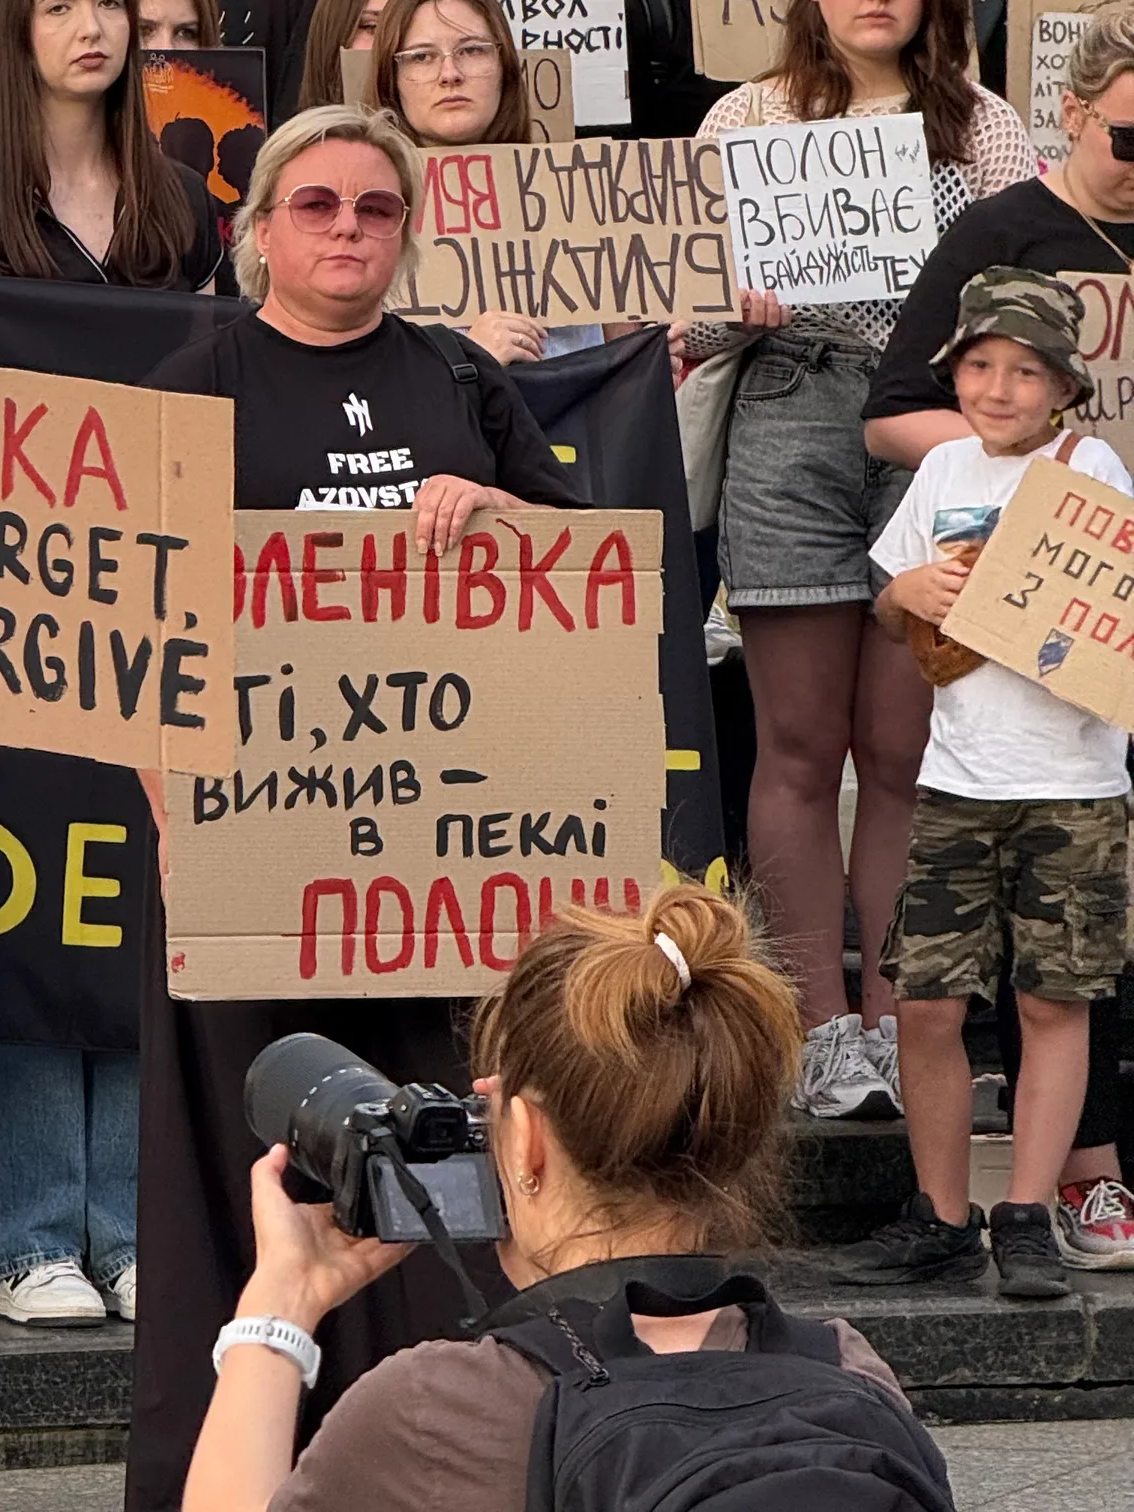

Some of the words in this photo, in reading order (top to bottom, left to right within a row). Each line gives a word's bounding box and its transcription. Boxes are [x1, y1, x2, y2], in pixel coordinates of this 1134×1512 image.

[726, 126, 887, 190] ПОЛОН
[739, 186, 922, 249] ВБИВАЄ
[297, 478, 428, 508] AZOVST
[327, 448, 414, 474] FREE
[234, 519, 636, 632] ЛЕНІВКА
[339, 671, 472, 742] ХТО
[193, 759, 422, 824] ВИЖИВ
